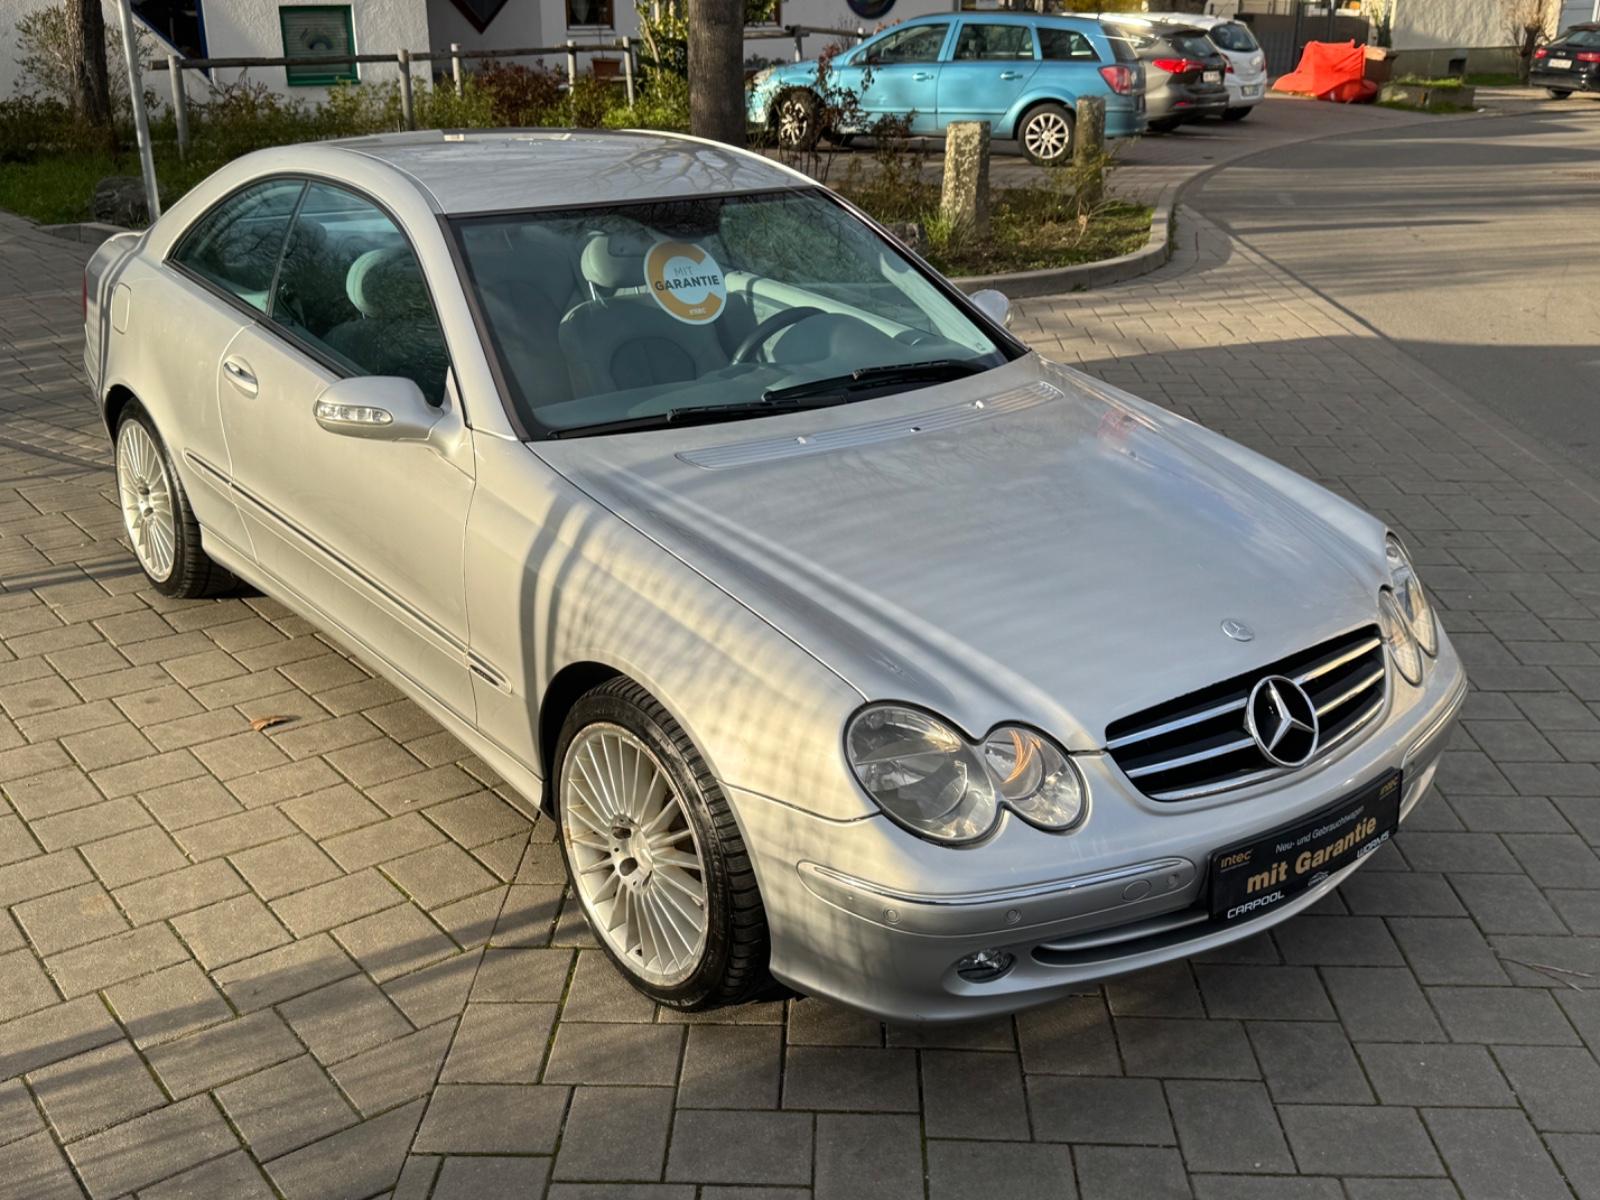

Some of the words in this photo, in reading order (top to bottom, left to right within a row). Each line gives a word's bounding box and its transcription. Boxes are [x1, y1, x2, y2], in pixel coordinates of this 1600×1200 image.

[674, 265, 693, 277] MIT
[655, 275, 720, 291] GARANTIE
[1275, 841, 1296, 854] Neu-
[1297, 832, 1311, 846] und
[1220, 849, 1253, 869] intec
[1247, 861, 1288, 894] mit
[1295, 815, 1377, 875] Garantie
[1227, 890, 1285, 919] CARPOOL
